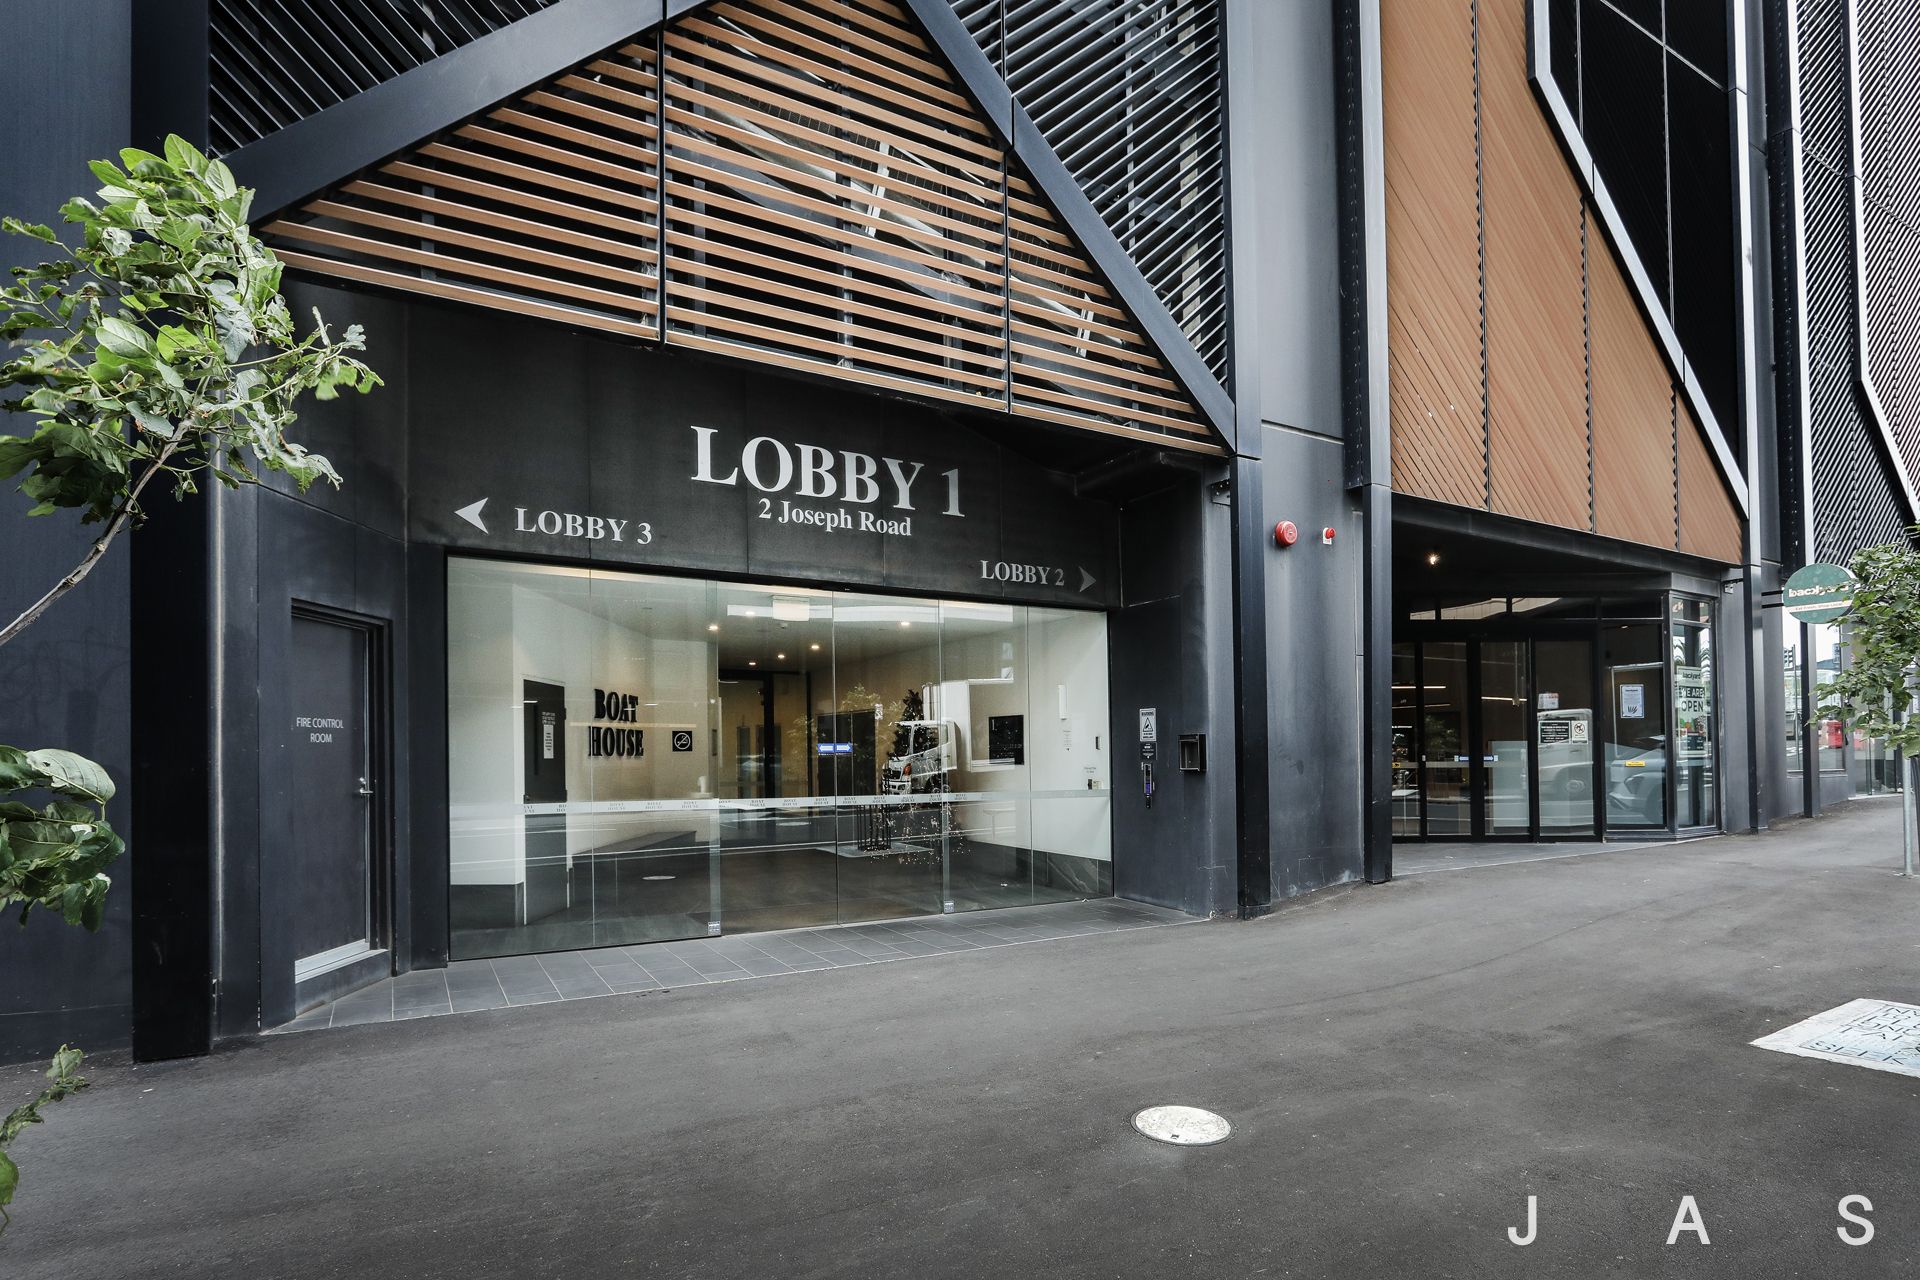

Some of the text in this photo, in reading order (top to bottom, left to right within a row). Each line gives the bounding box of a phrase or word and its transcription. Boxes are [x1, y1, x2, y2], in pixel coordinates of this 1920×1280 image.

[691, 425, 965, 517] LOBBY 1
[514, 507, 652, 545] LOBBY 3
[758, 498, 912, 536] 2 Joseph Road
[980, 560, 1065, 586] LOBBY 2
[1788, 582, 1849, 598] backyad
[594, 688, 639, 722] BOAT
[1681, 701, 1704, 713] OPEN
[296, 717, 344, 729] FIRE CONTROL
[310, 733, 333, 743] ROOM
[588, 726, 644, 757] HOUSE
